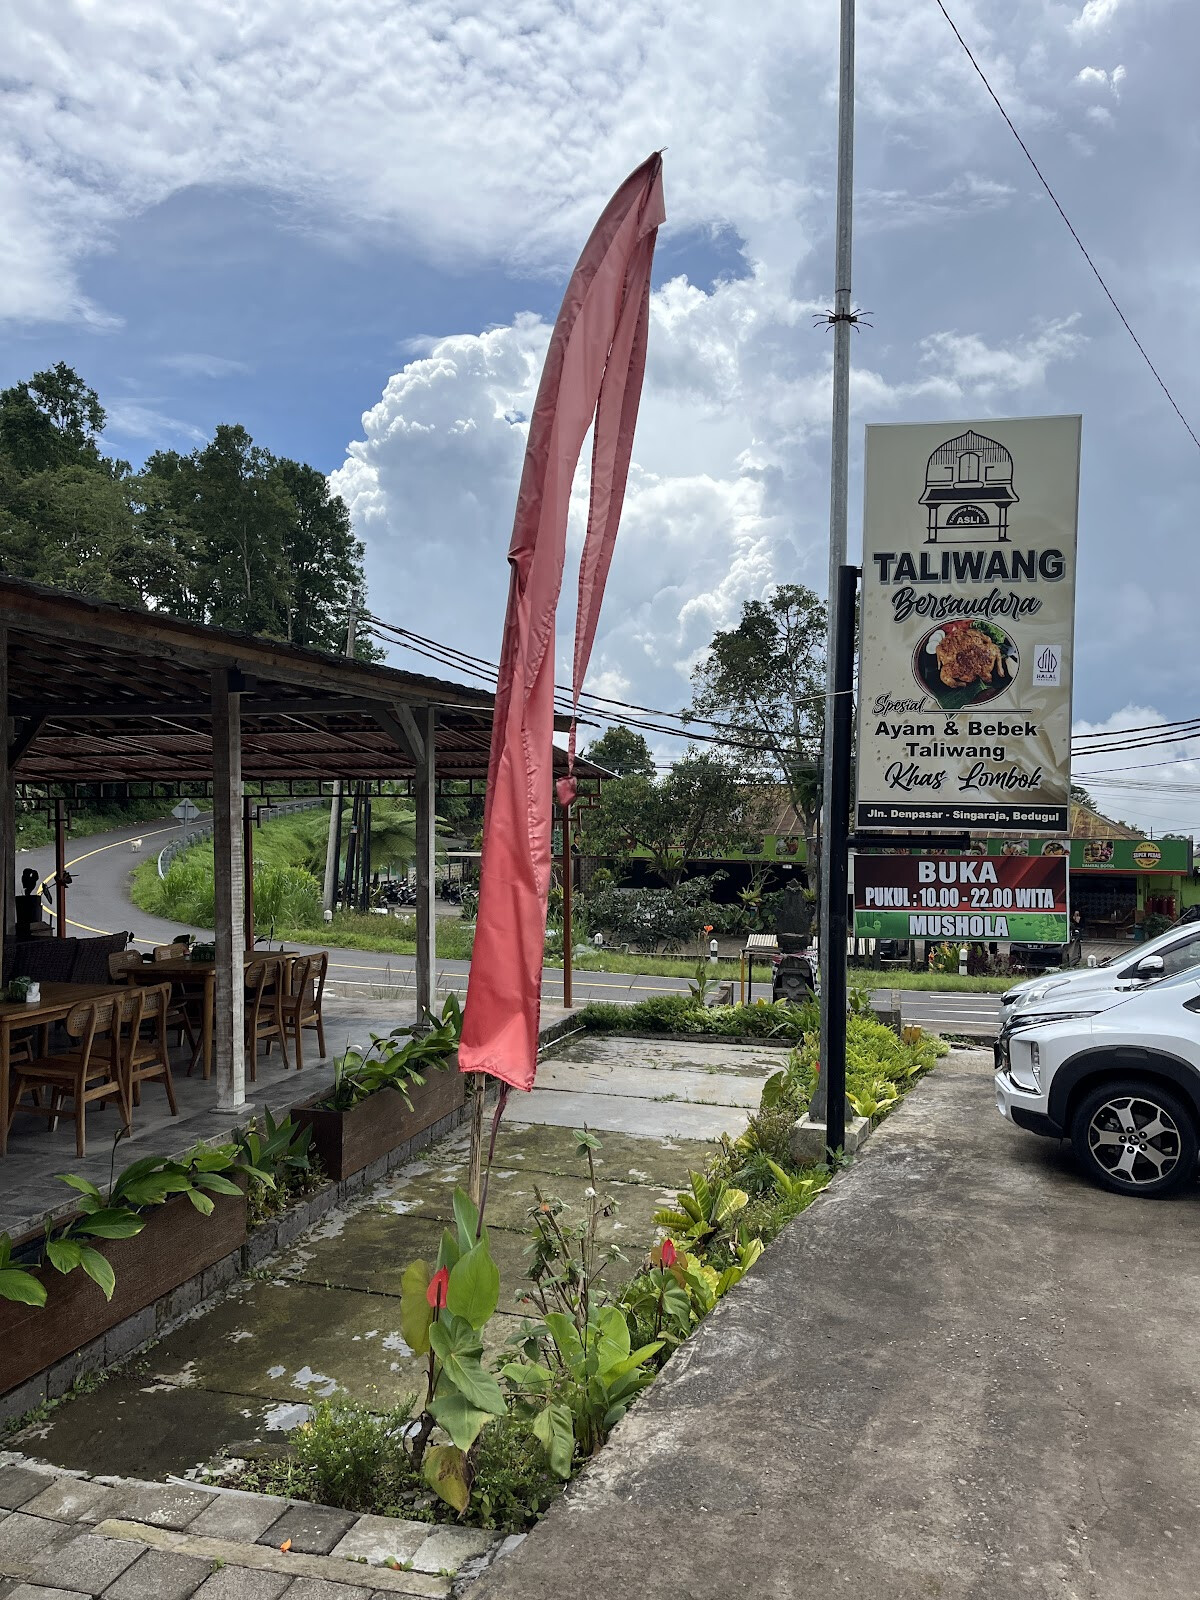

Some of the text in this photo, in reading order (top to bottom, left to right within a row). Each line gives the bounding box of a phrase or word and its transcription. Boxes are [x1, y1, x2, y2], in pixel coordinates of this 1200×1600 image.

[957, 516, 980, 524] ASLI
[873, 549, 1065, 584] TALIWANG
[892, 587, 1042, 623] Bersaudara
[872, 693, 926, 716] Spesial
[875, 721, 1039, 739] Ayam & Bebek
[906, 742, 1006, 762] Taliwang
[884, 761, 1043, 791] Khas Lombok
[867, 809, 888, 818] Jln.
[890, 809, 943, 820] Denpasar
[952, 810, 1010, 822] Singaraja,
[1012, 811, 1060, 822] Bedugul
[918, 861, 998, 884] BUKA
[865, 887, 911, 907] PUKUL
[919, 887, 959, 907] 10.00
[970, 888, 1012, 908] 22.00
[1015, 888, 1055, 909] WITA
[909, 915, 1010, 937] MUSHOLA
